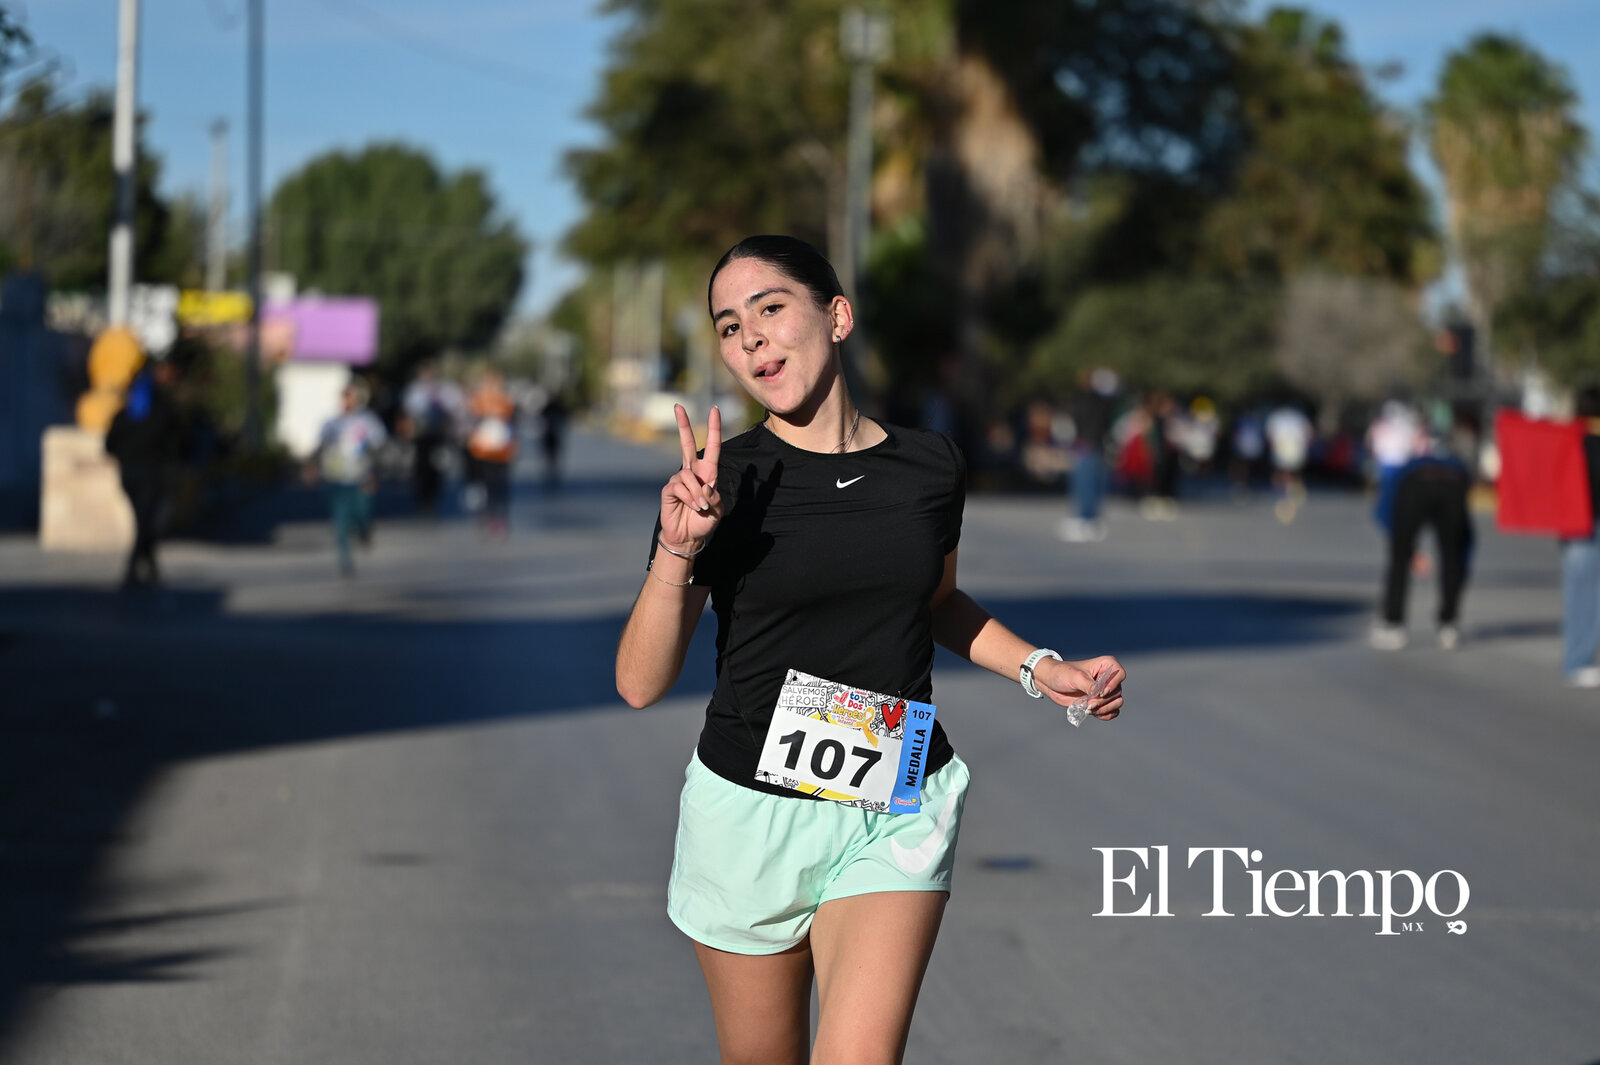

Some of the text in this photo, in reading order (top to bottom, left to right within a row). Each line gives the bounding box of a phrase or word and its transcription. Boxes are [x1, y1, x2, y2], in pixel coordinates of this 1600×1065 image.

[782, 685, 825, 697] SALVEMOS
[850, 691, 860, 701] to
[782, 694, 825, 707] HÉROES
[911, 709, 932, 721] 107
[778, 729, 883, 788] 107
[905, 728, 927, 787] MEDALLA
